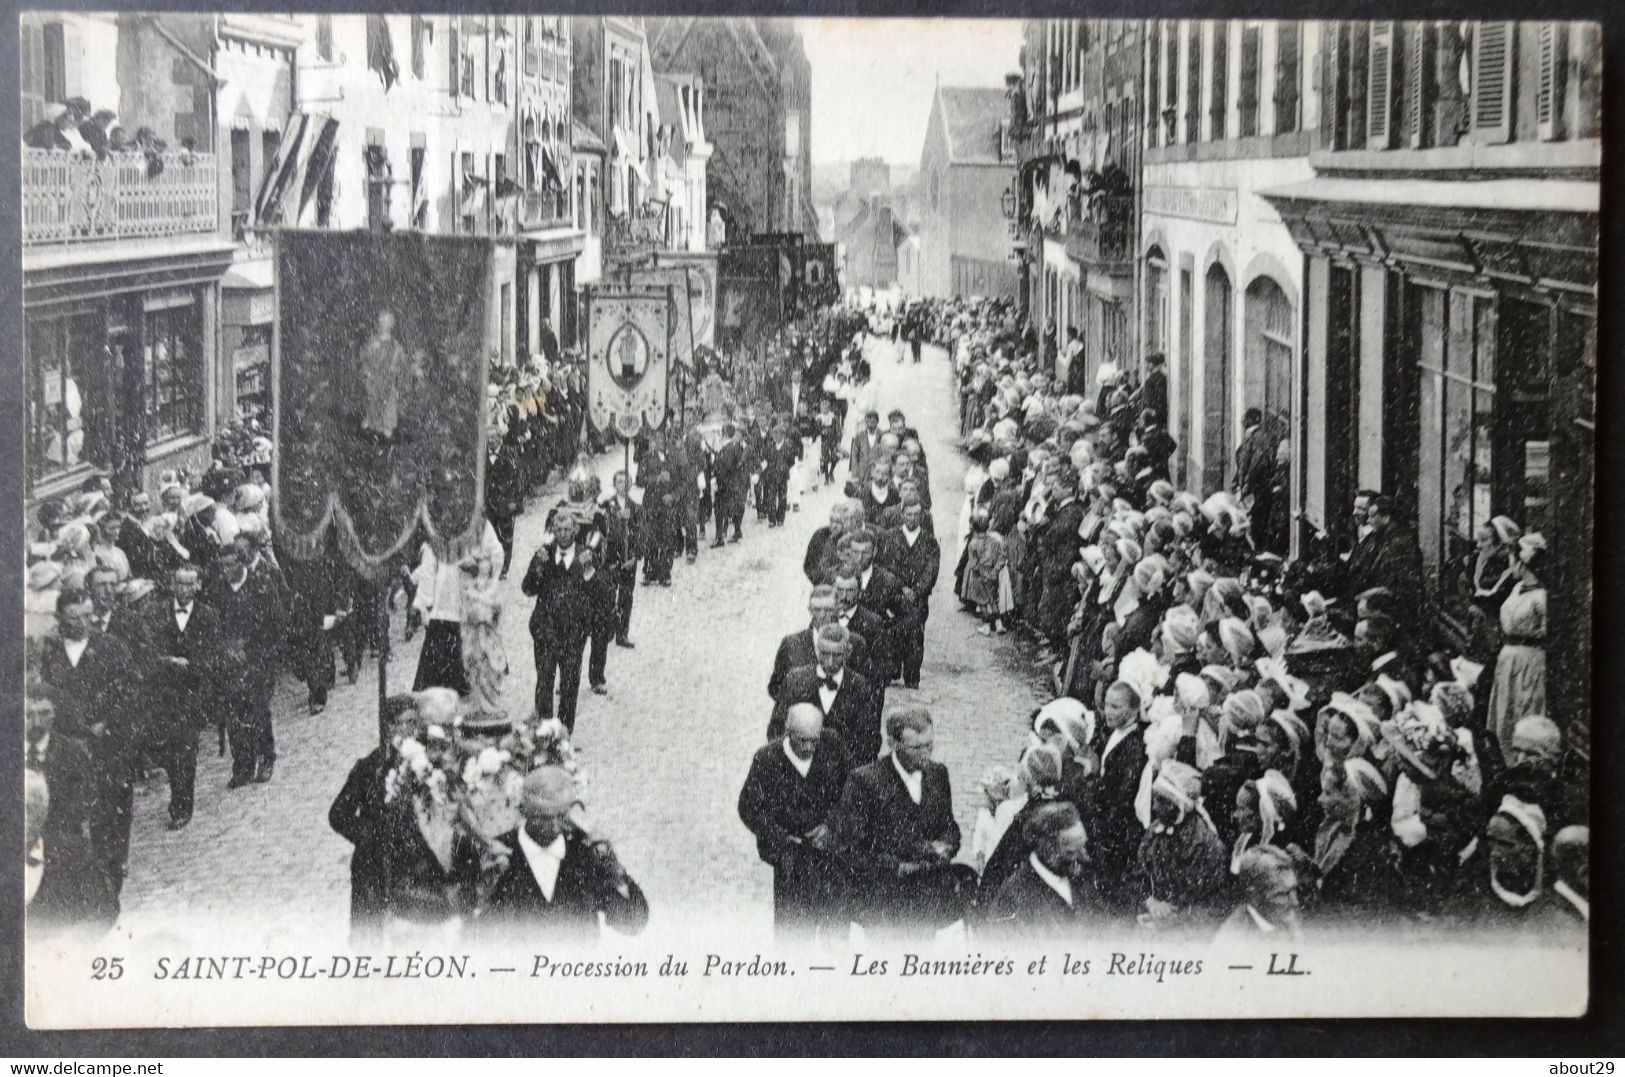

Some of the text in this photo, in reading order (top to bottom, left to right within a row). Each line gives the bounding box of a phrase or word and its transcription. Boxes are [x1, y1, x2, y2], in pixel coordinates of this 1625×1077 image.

[91, 957, 124, 980] 25
[154, 951, 477, 979] SAINT-POL-DE-LÉON.
[531, 955, 648, 977] Procession
[658, 955, 688, 976] du
[704, 955, 797, 976] Pardon.
[850, 953, 889, 975] Les
[901, 953, 1015, 976] Bannières
[1027, 955, 1047, 975] et
[1062, 953, 1091, 975] les
[1107, 953, 1203, 983] Reliques
